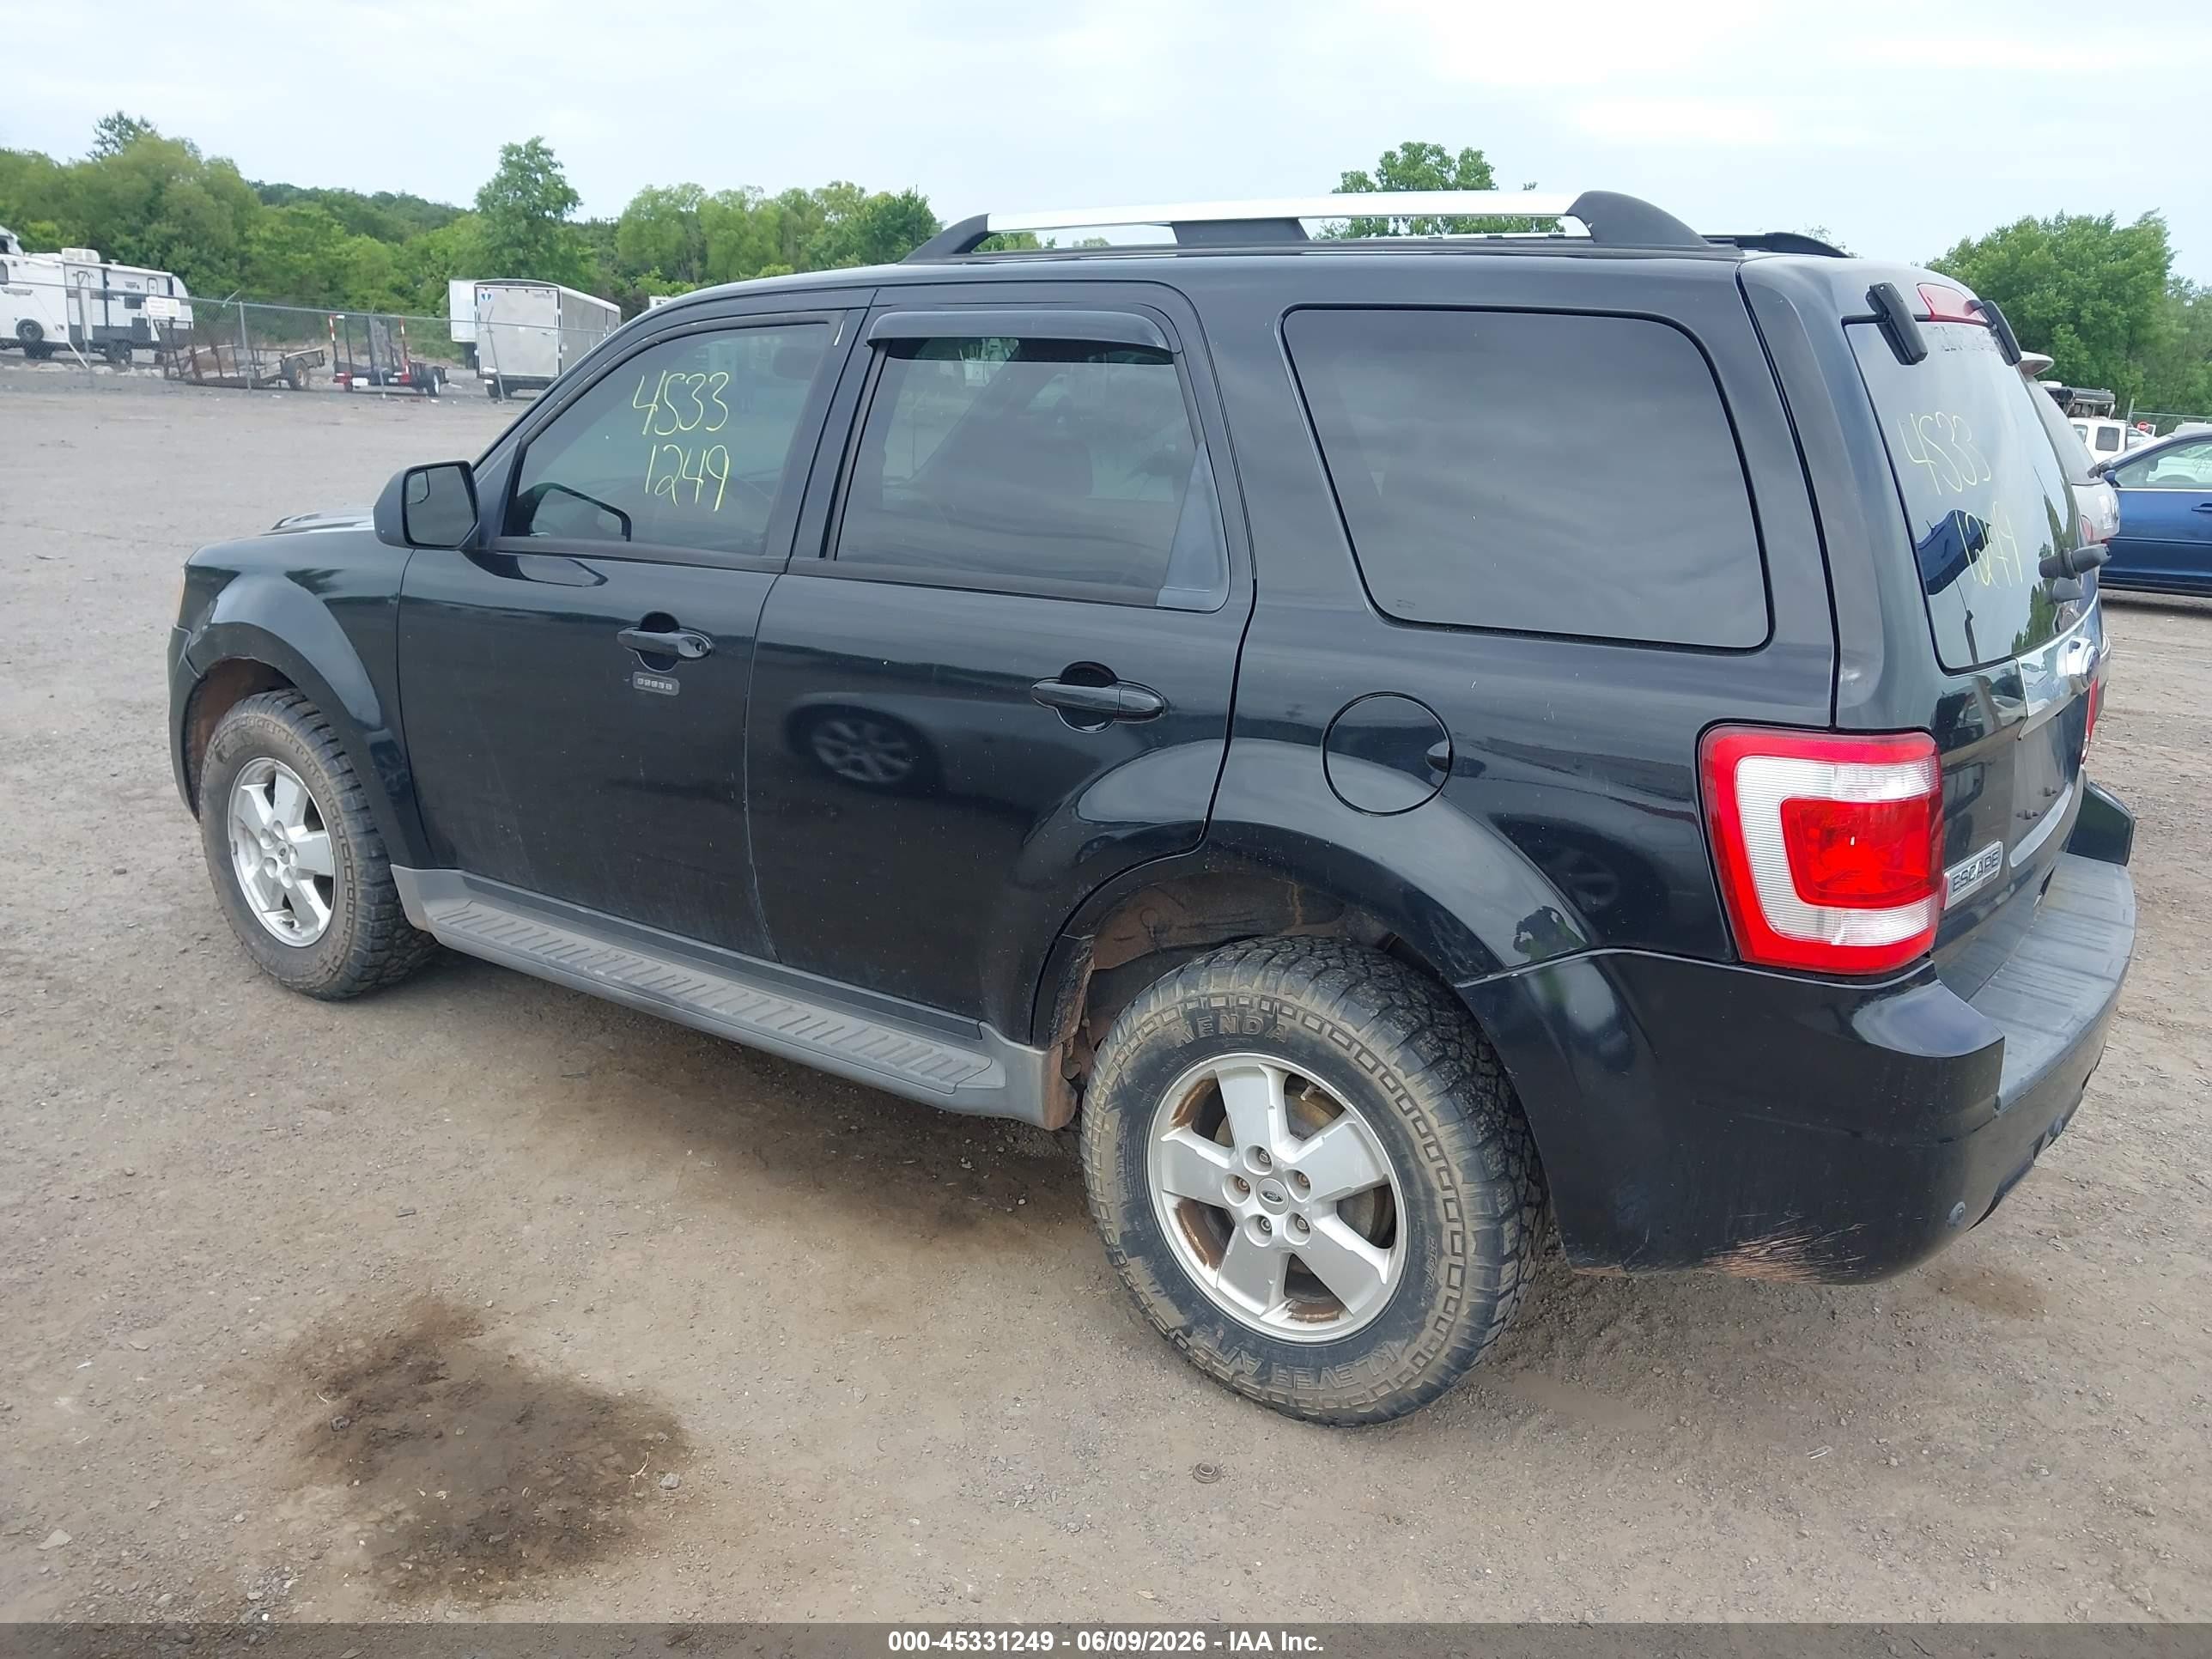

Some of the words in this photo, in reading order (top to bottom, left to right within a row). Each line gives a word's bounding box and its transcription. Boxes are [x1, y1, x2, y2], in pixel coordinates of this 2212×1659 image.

[632, 369, 730, 436] 4533
[645, 444, 730, 513] 1249
[1897, 411, 1992, 496] 4533
[1953, 501, 2023, 589] 1249
[1952, 848, 2000, 894] ESCAPE
[1174, 1014, 1286, 1048] KENDA
